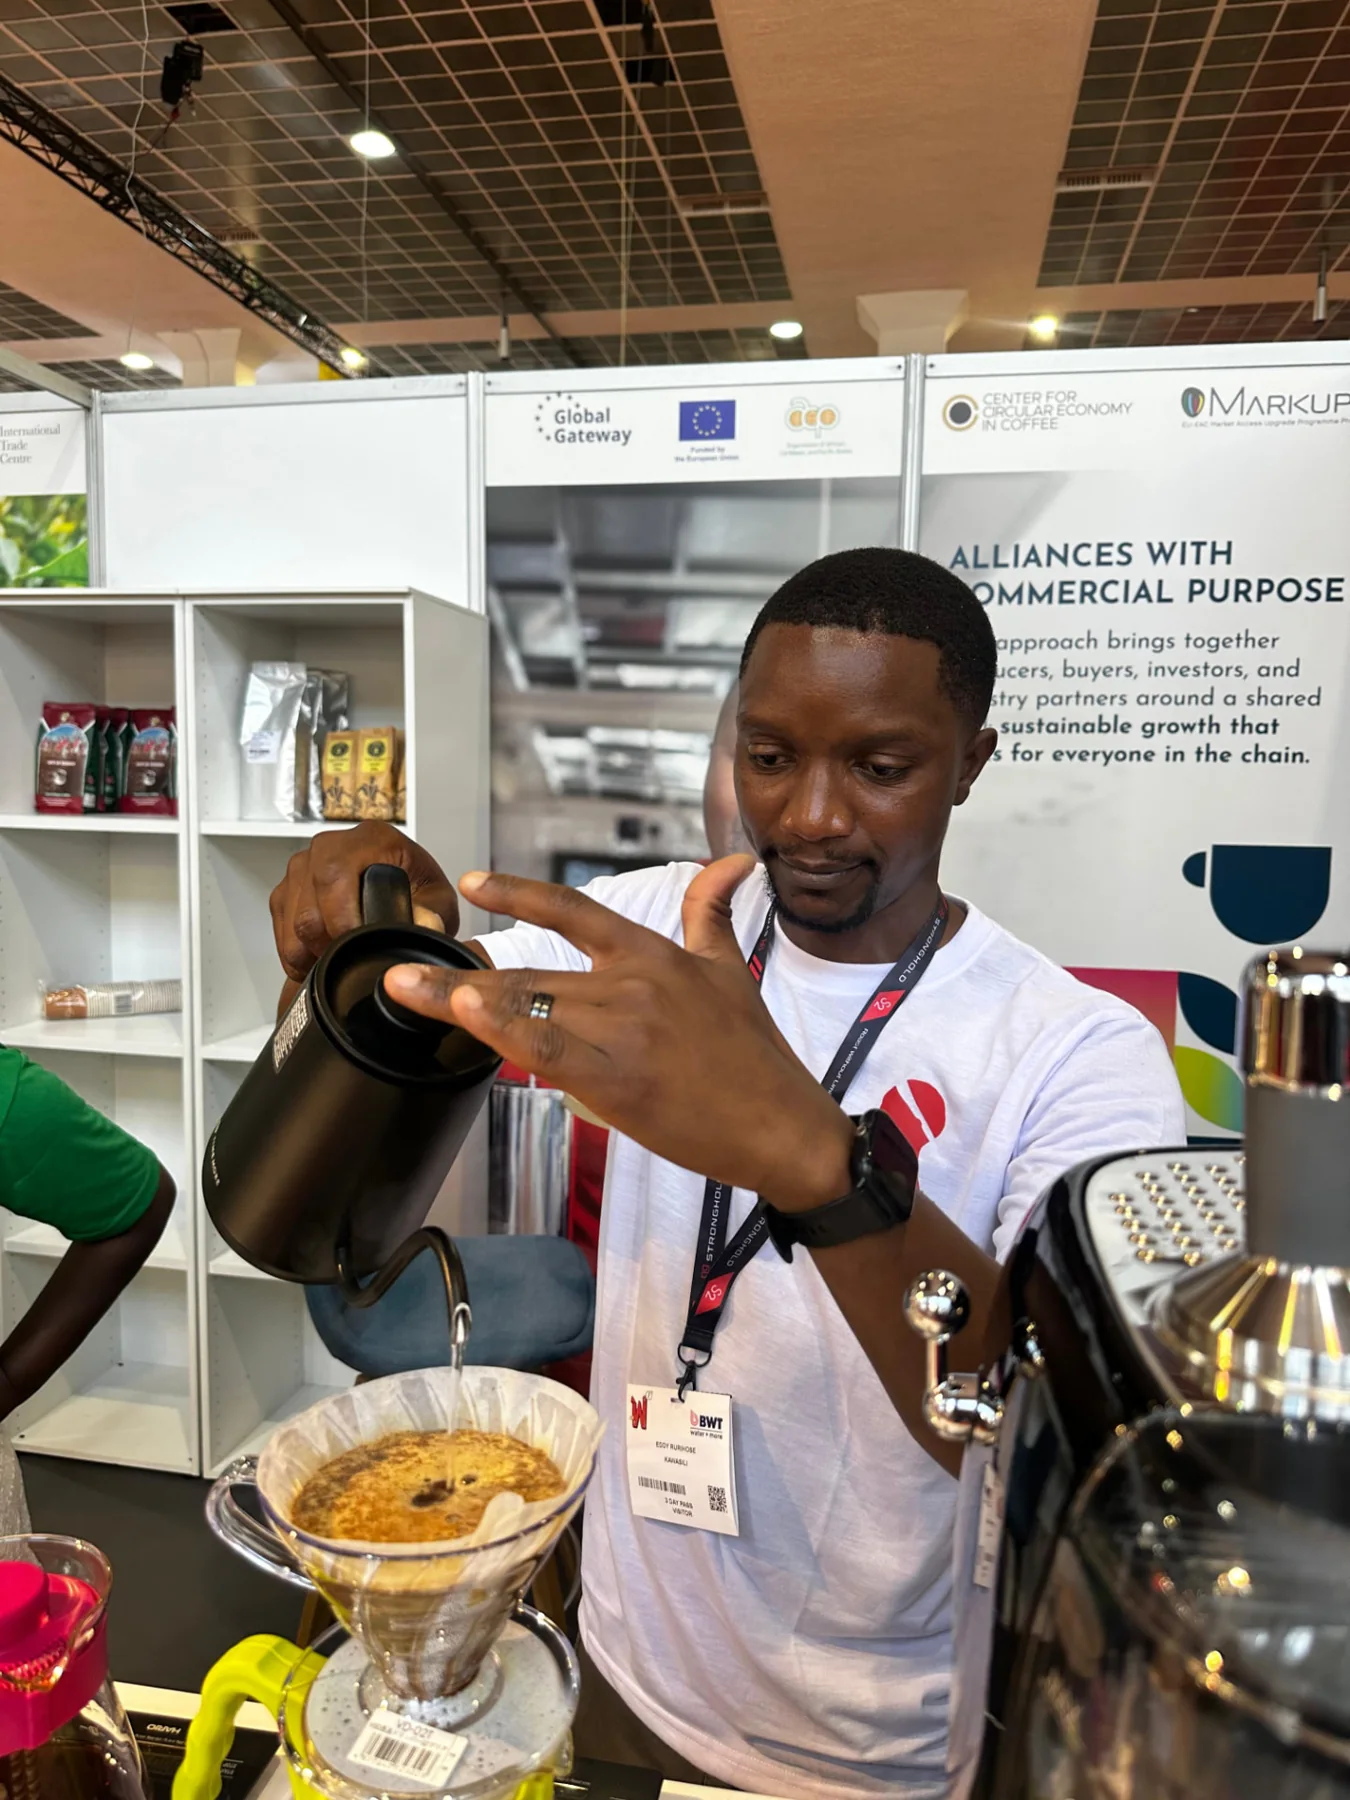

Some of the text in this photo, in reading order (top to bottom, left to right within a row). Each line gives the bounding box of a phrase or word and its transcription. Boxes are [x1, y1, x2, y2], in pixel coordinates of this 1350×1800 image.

[982, 390, 1077, 405] CENTER FOR
[554, 407, 611, 425] Global
[982, 402, 1133, 418] CIRCULAR ECONOMY
[0, 423, 61, 437] International
[982, 417, 1059, 432] IN COFFEE
[0, 439, 29, 451] Trade
[554, 428, 632, 446] Gateway
[0, 452, 33, 465] Centre
[950, 540, 1233, 570] ALLIANCES WITH
[973, 577, 1345, 606] OMMERCIAL PURPOSE
[996, 628, 1280, 655] approach brings together
[996, 657, 1301, 682] ucers, buyers, investors, and
[990, 686, 1322, 711] stry partners around a shared
[1000, 714, 1280, 739] sustainable growth that
[1011, 742, 1044, 762] for
[1052, 748, 1156, 767] everyone
[1165, 745, 1186, 763] in
[1195, 742, 1232, 763] the
[1241, 742, 1310, 764] chain.
[898, 917, 941, 983] STRONGHOLD
[706, 1181, 722, 1262] STRONGHOL
[727, 1216, 766, 1267] RONGHOLD
[699, 1415, 723, 1430] BWT
[146, 1723, 182, 1735] HARIO
